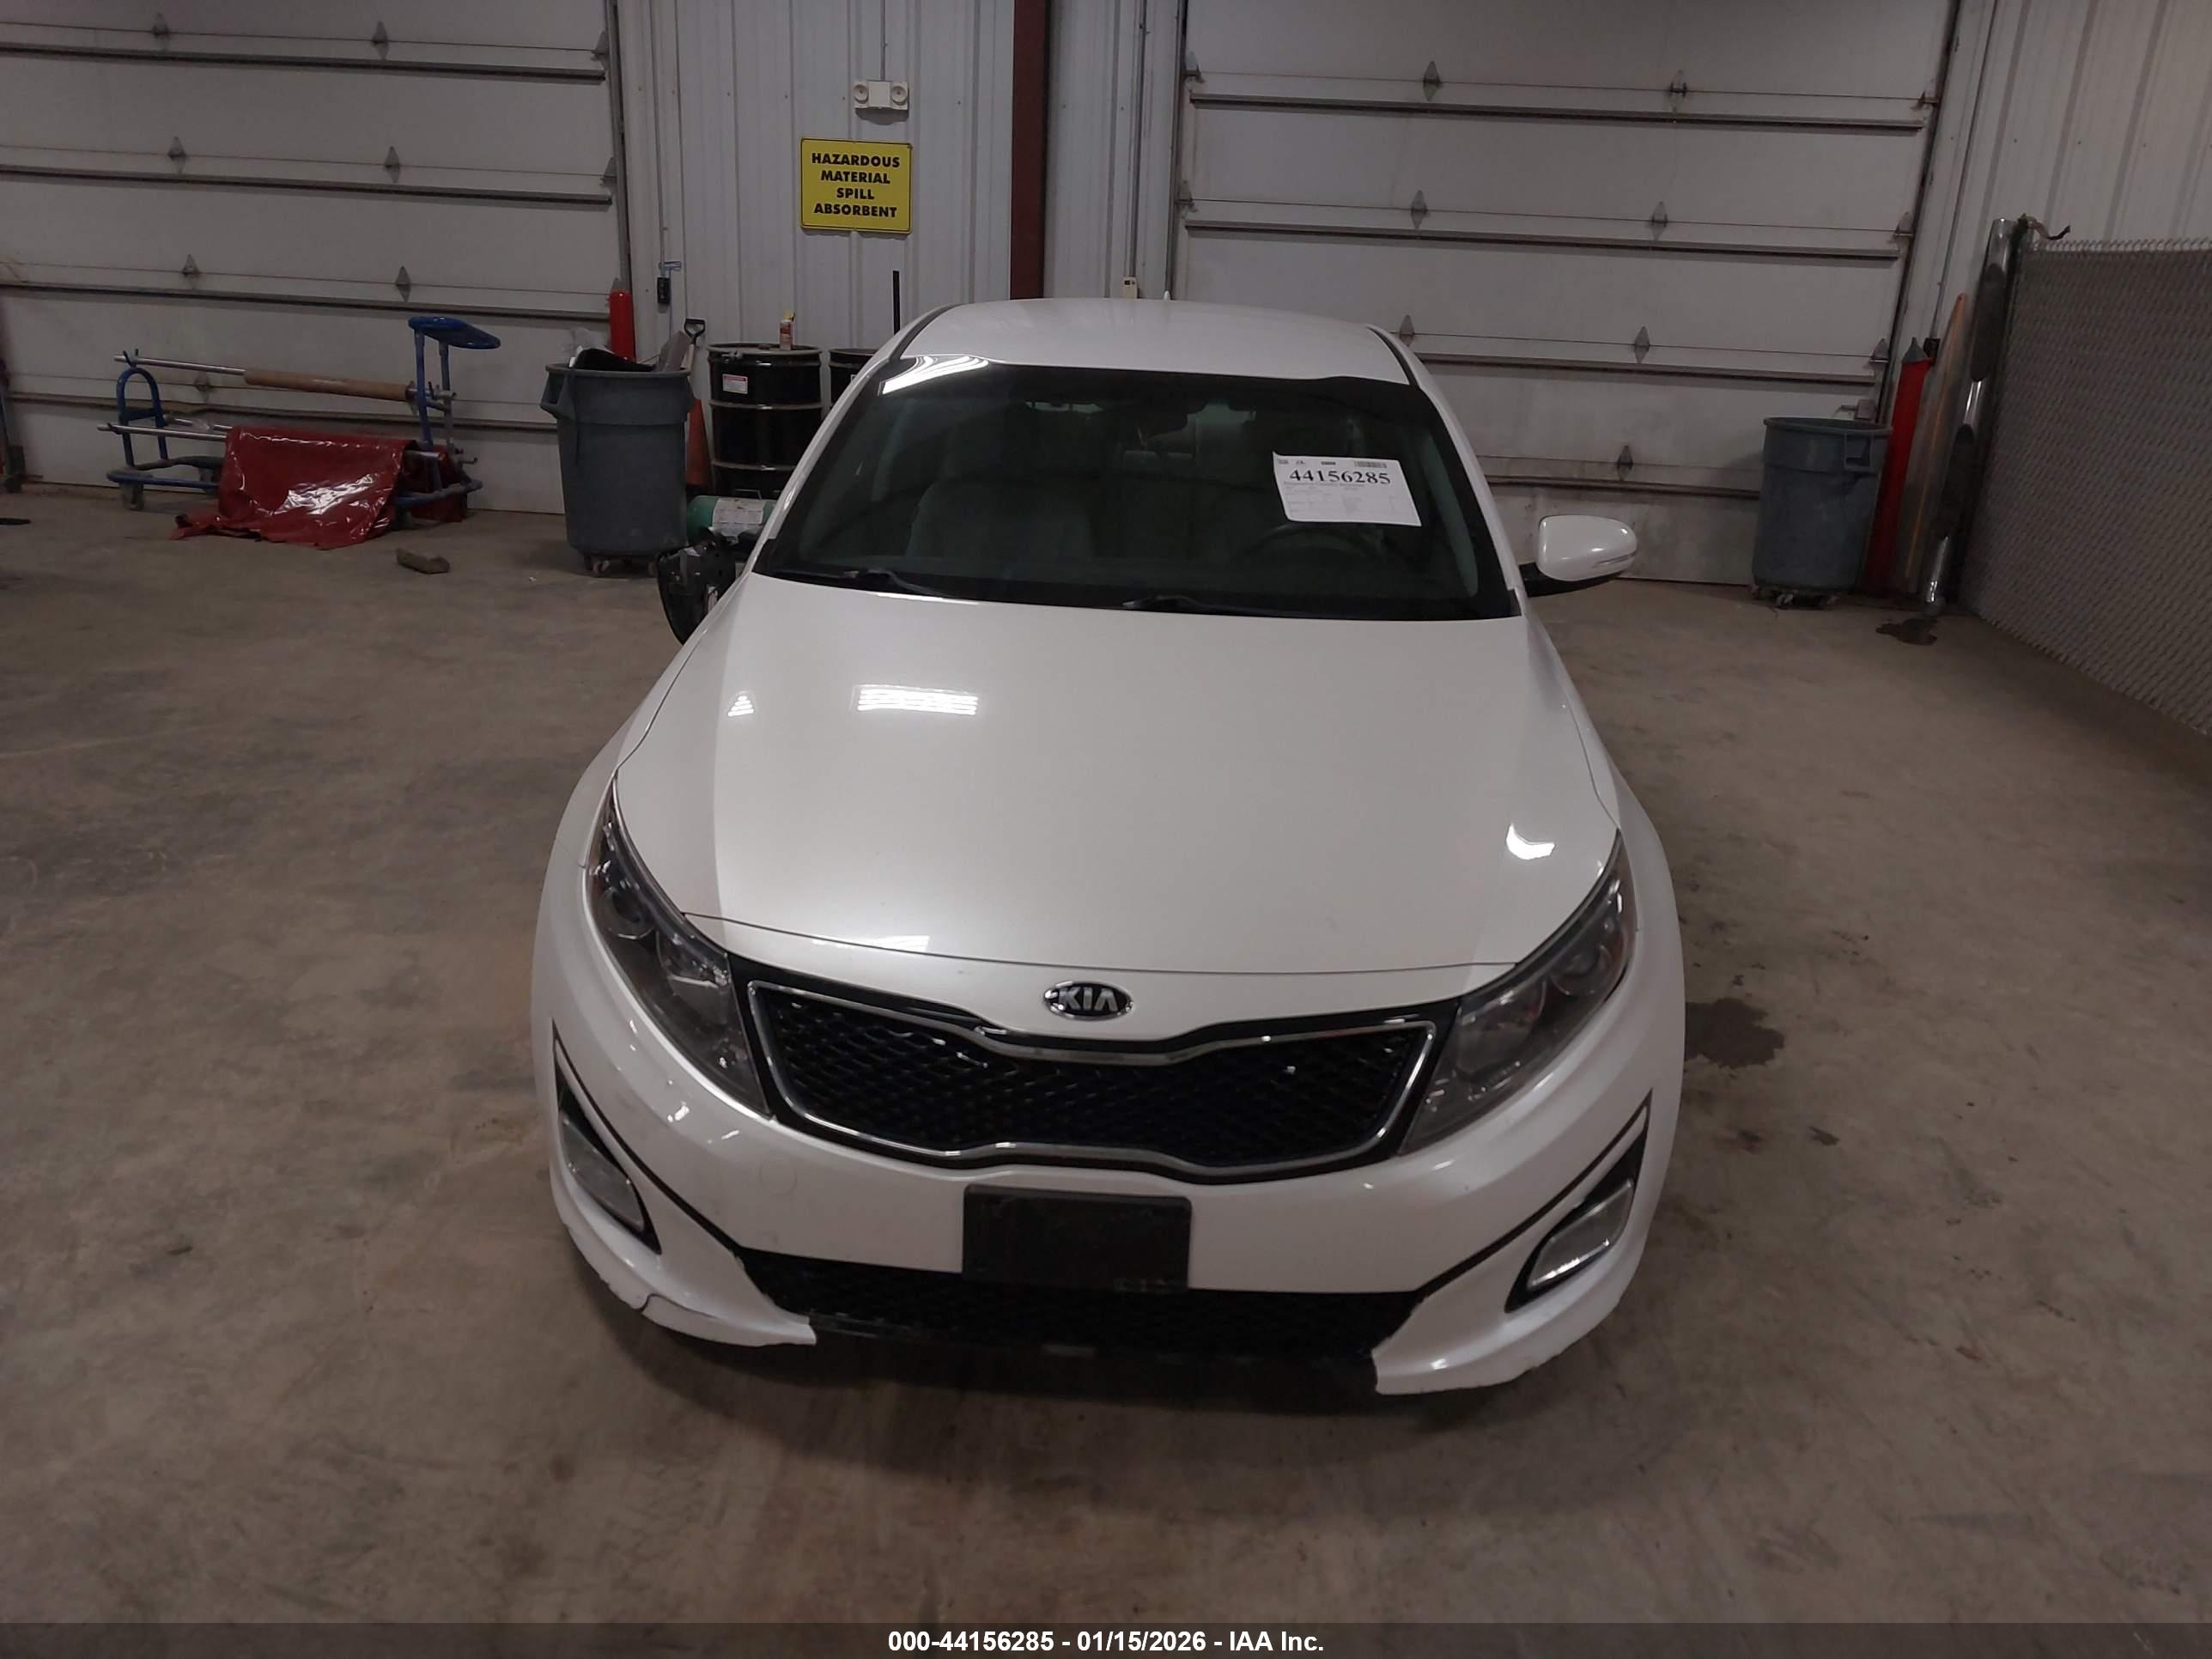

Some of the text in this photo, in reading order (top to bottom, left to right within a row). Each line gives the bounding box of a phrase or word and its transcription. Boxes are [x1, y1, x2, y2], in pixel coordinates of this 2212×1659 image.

[811, 153, 900, 167] HAZARDOUS
[821, 170, 890, 184] MATERIAL
[836, 187, 874, 200] SPILL
[813, 203, 897, 217] ABSORBENT
[1289, 469, 1391, 485] 44156285
[1058, 986, 1118, 1012] KIA
